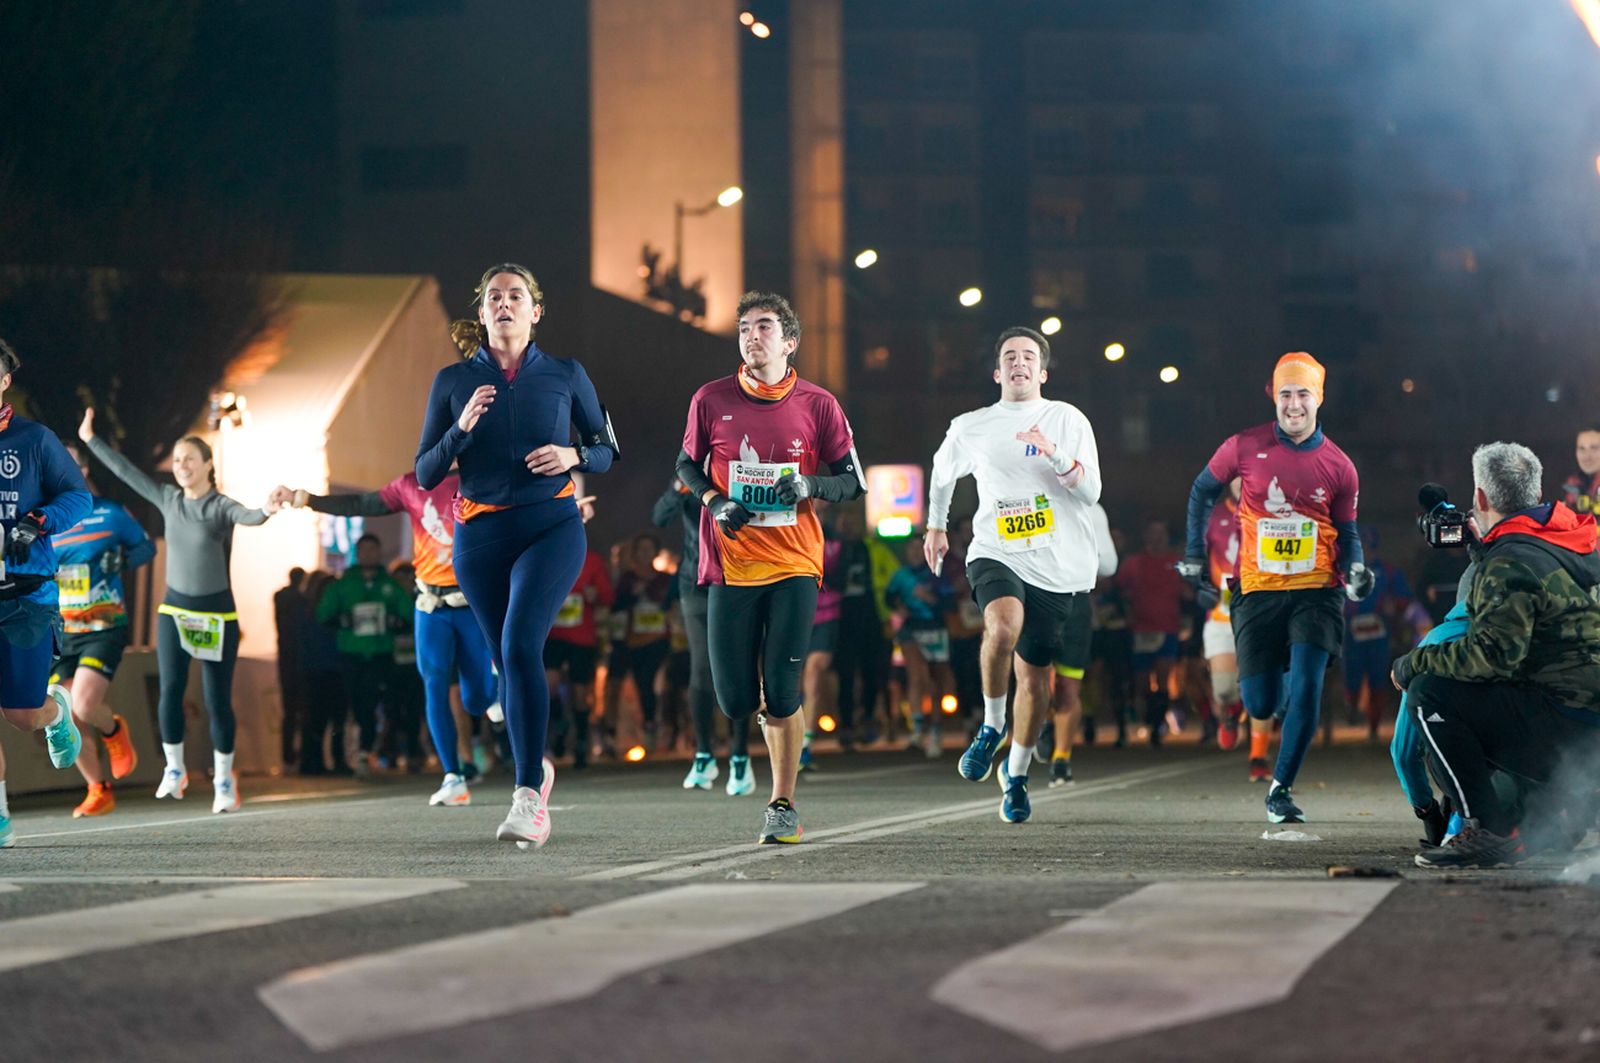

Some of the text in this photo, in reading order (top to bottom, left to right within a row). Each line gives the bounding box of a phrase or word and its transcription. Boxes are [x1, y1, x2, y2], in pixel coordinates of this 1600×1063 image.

[736, 475, 749, 483] SAN
[742, 485, 784, 505] 800
[1005, 511, 1046, 534] 3266
[1274, 539, 1302, 555] 447
